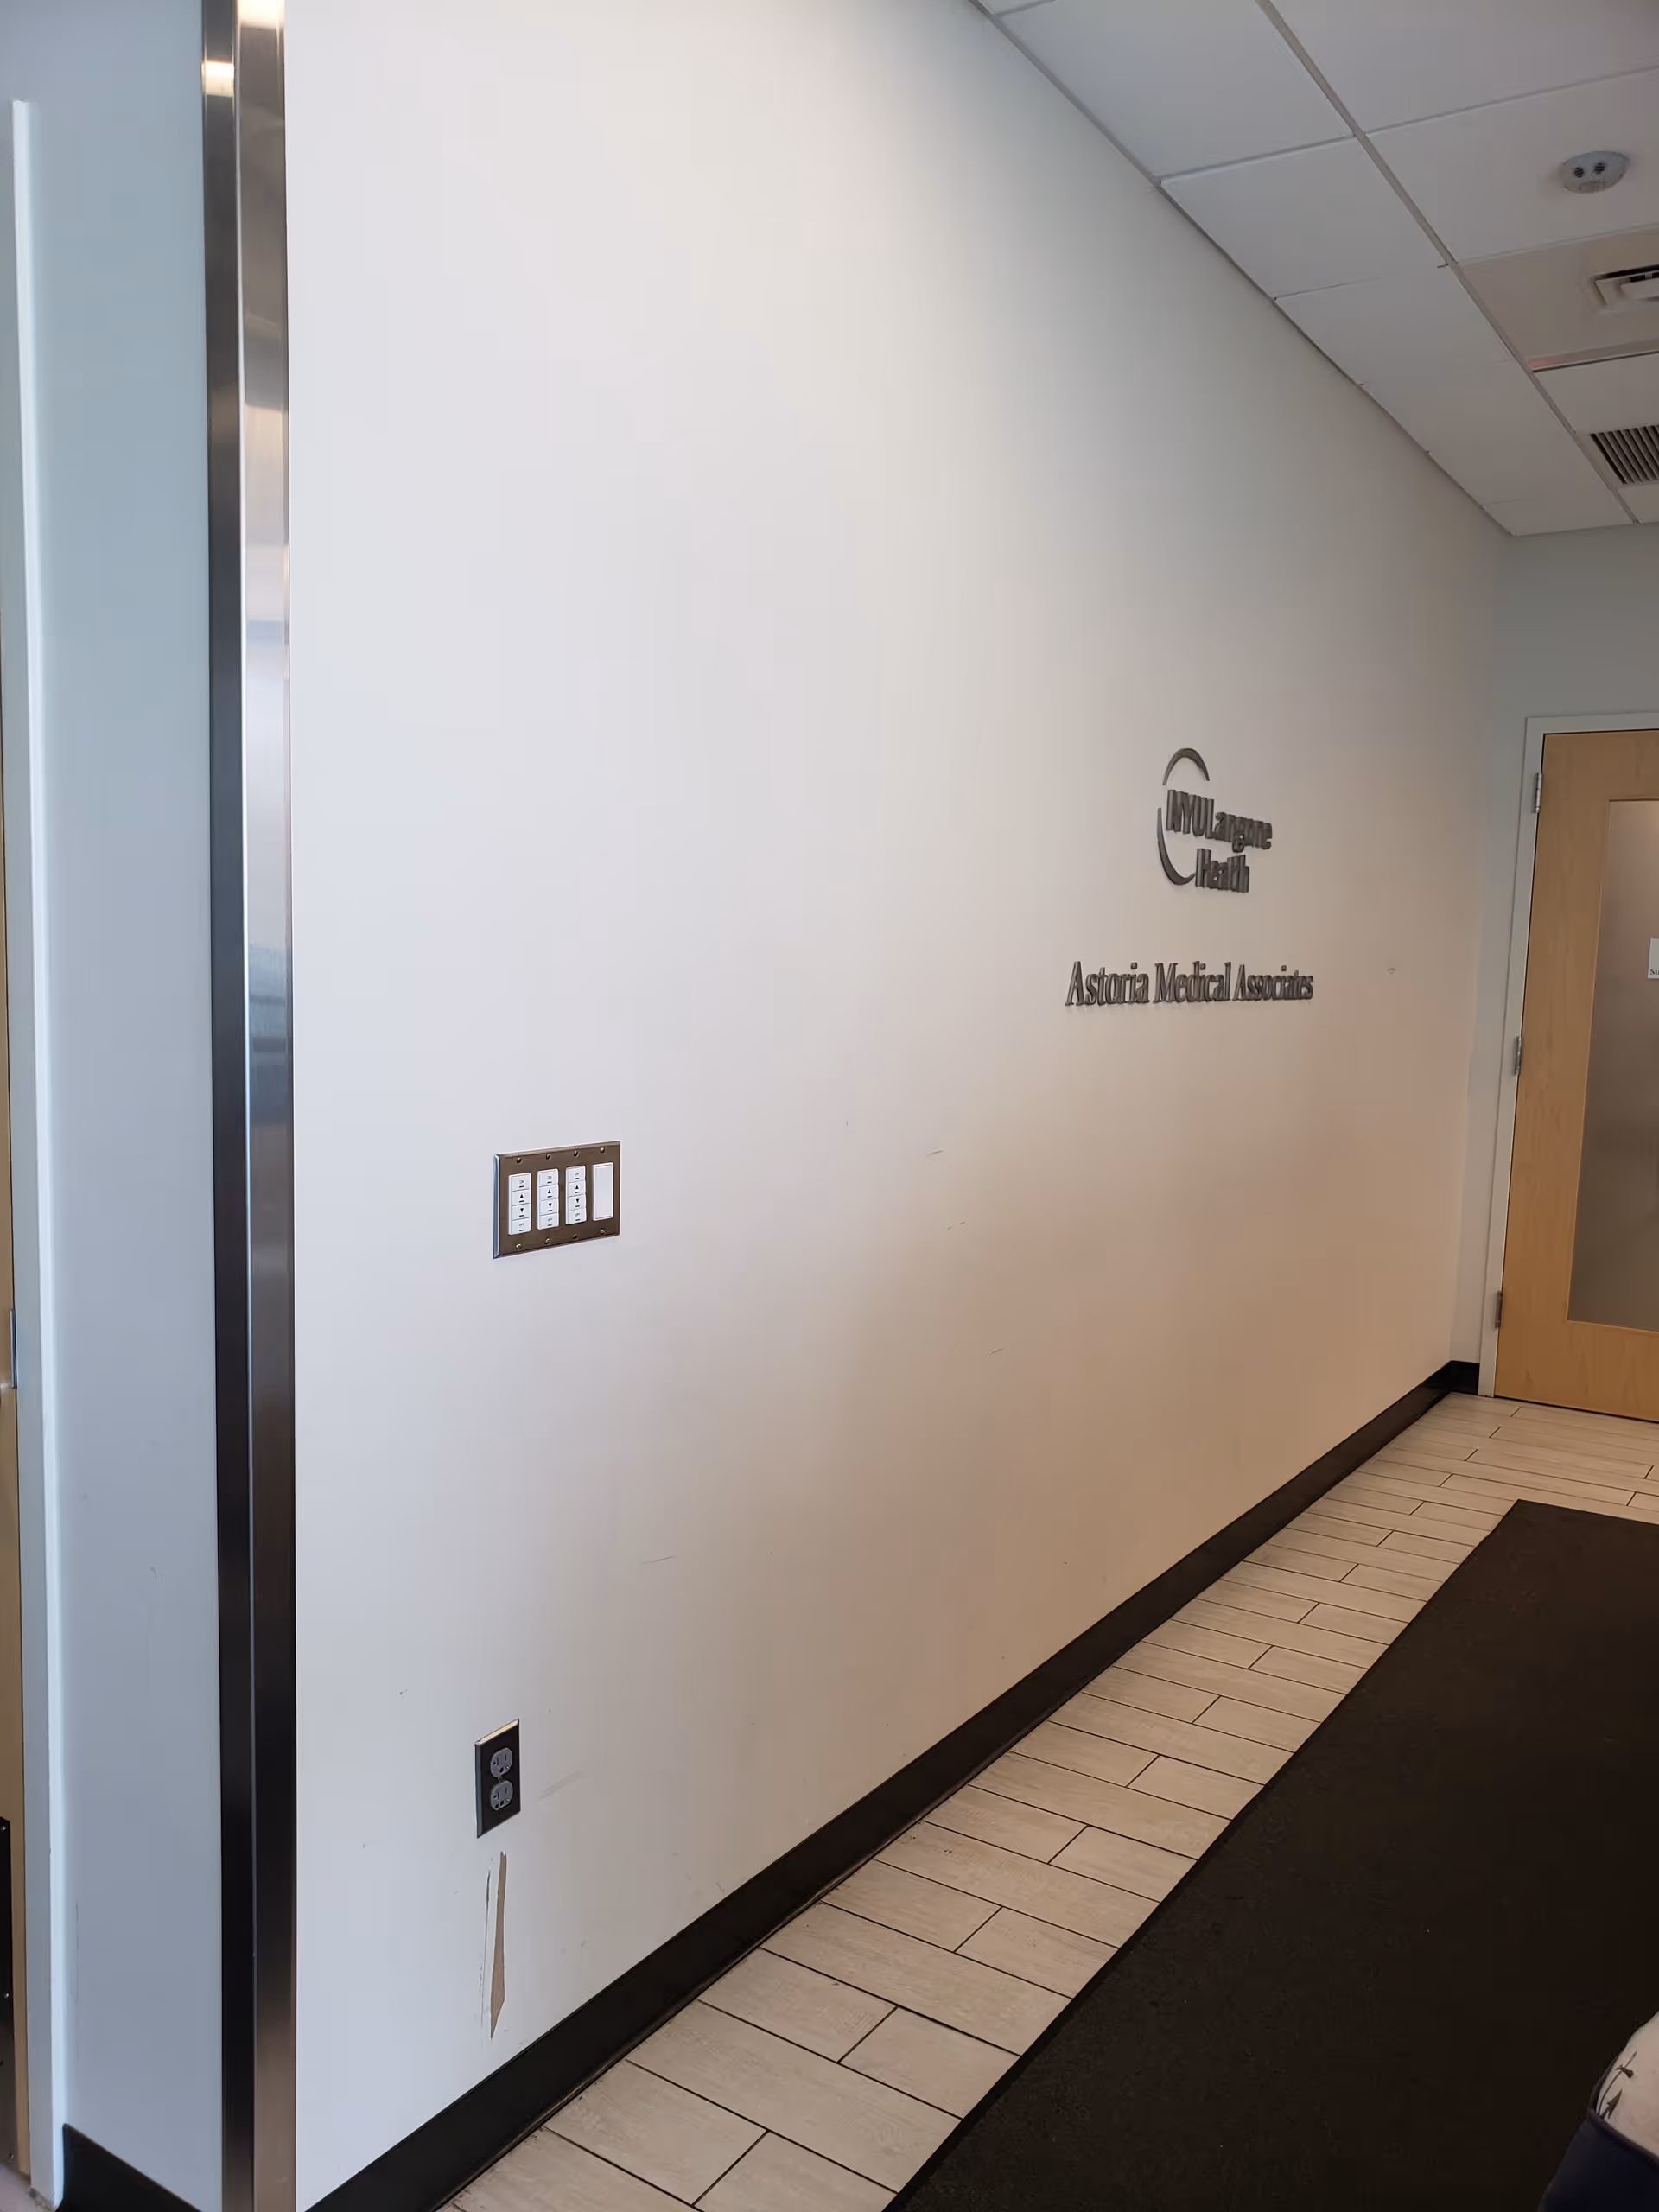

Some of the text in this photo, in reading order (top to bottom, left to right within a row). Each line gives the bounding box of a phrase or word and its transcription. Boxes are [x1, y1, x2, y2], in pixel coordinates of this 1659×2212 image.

[1195, 848, 1249, 893] Health
[1065, 960, 1314, 1006] Astoria Medical Associates
